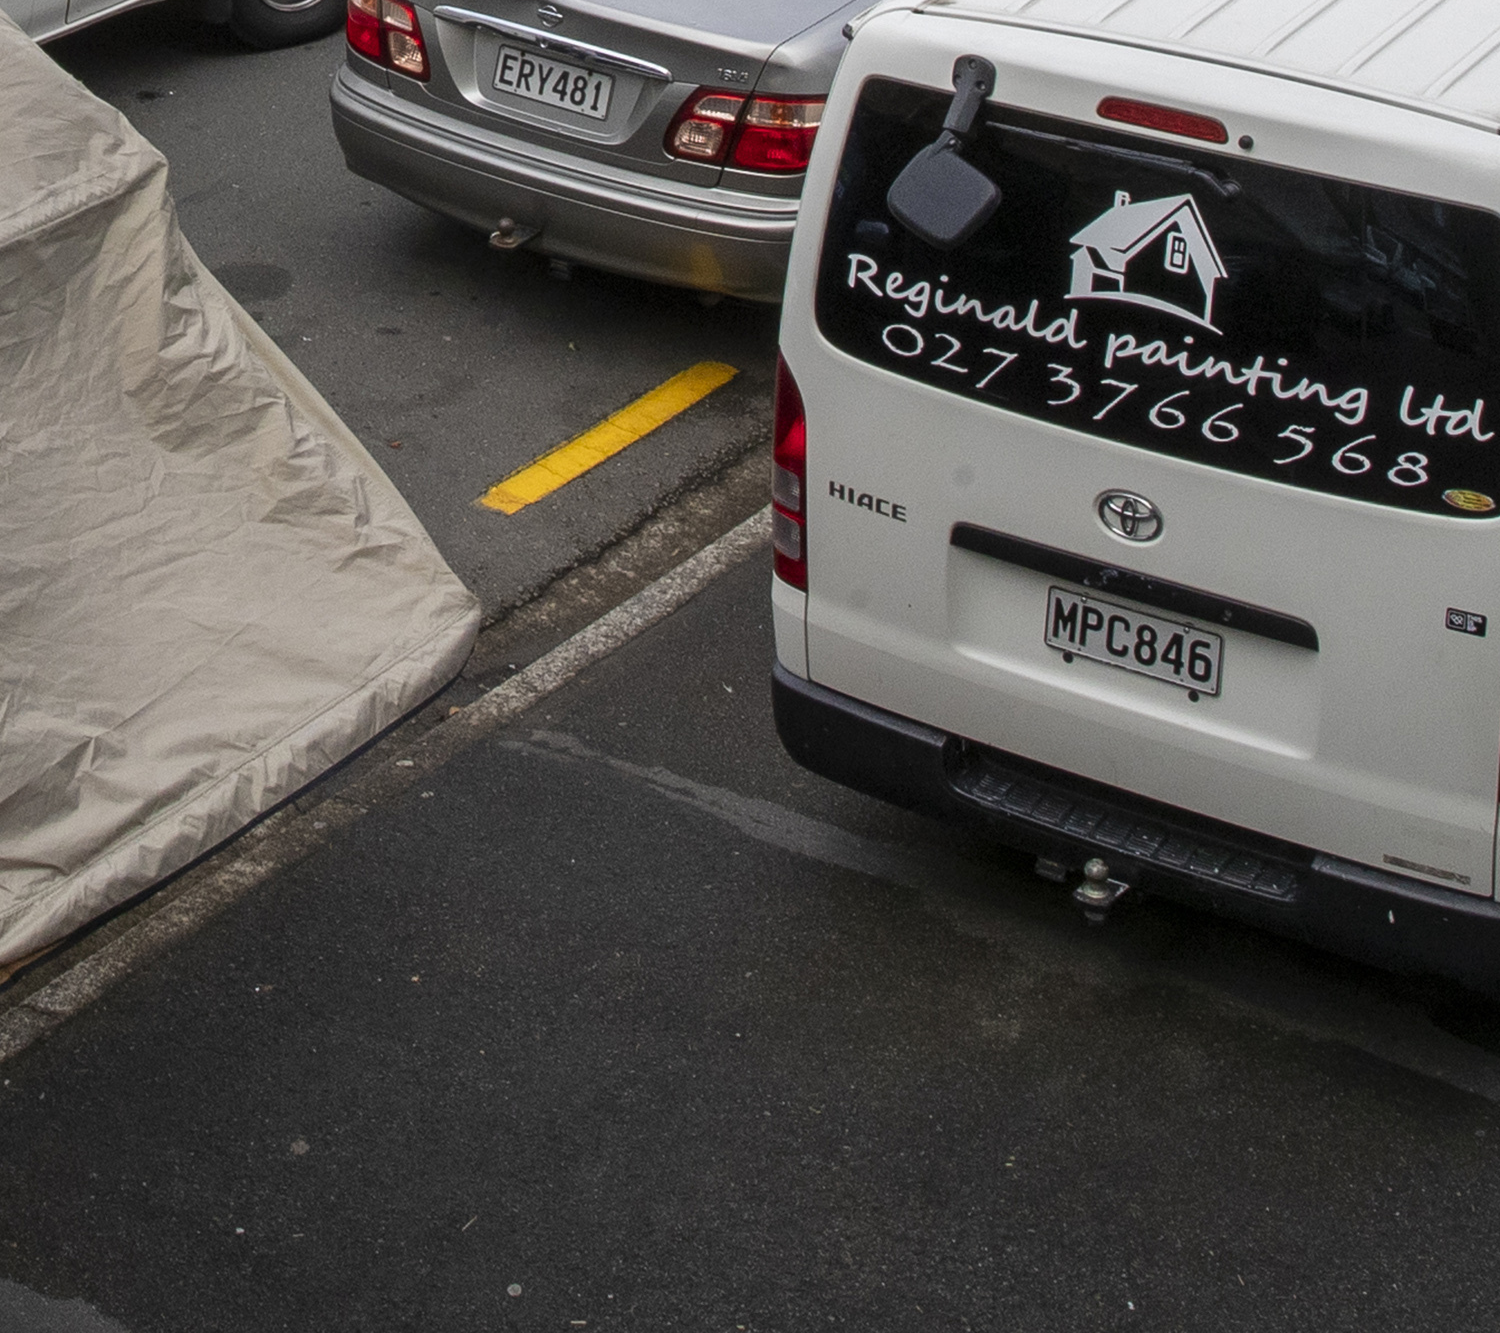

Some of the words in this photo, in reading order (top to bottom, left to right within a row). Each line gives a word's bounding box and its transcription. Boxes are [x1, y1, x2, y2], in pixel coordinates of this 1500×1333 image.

[499, 52, 603, 112] ERY481
[847, 253, 1086, 350] Reginald
[1104, 333, 1369, 423] painting
[882, 324, 1018, 388] 027
[1047, 363, 1244, 442] 3766
[1274, 424, 1429, 487] 568
[829, 480, 907, 522] HIACE
[1052, 597, 1212, 683] MPC846
